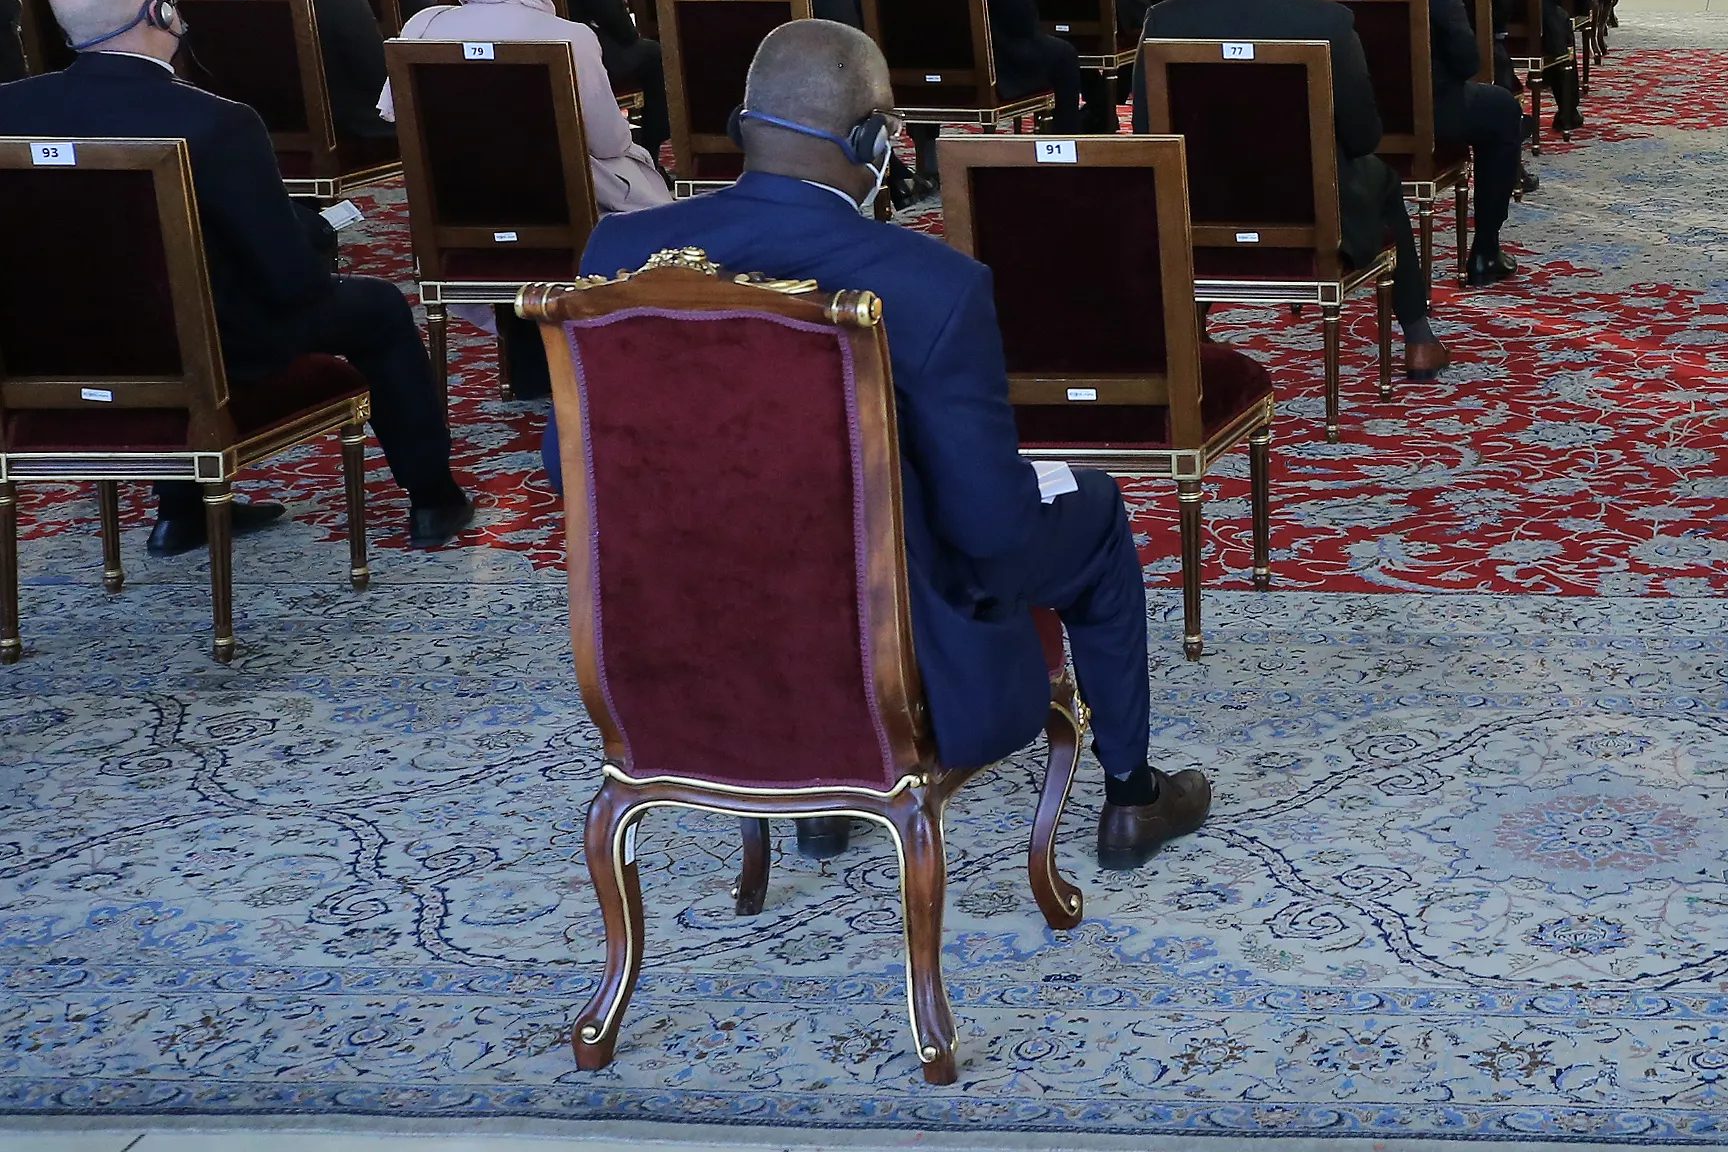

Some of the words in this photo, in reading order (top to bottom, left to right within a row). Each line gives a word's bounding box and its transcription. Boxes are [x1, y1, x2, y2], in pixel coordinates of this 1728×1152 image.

[471, 47, 484, 56] 79
[1230, 46, 1243, 55] 77
[41, 147, 59, 158] 93
[1046, 144, 1061, 155] 91
